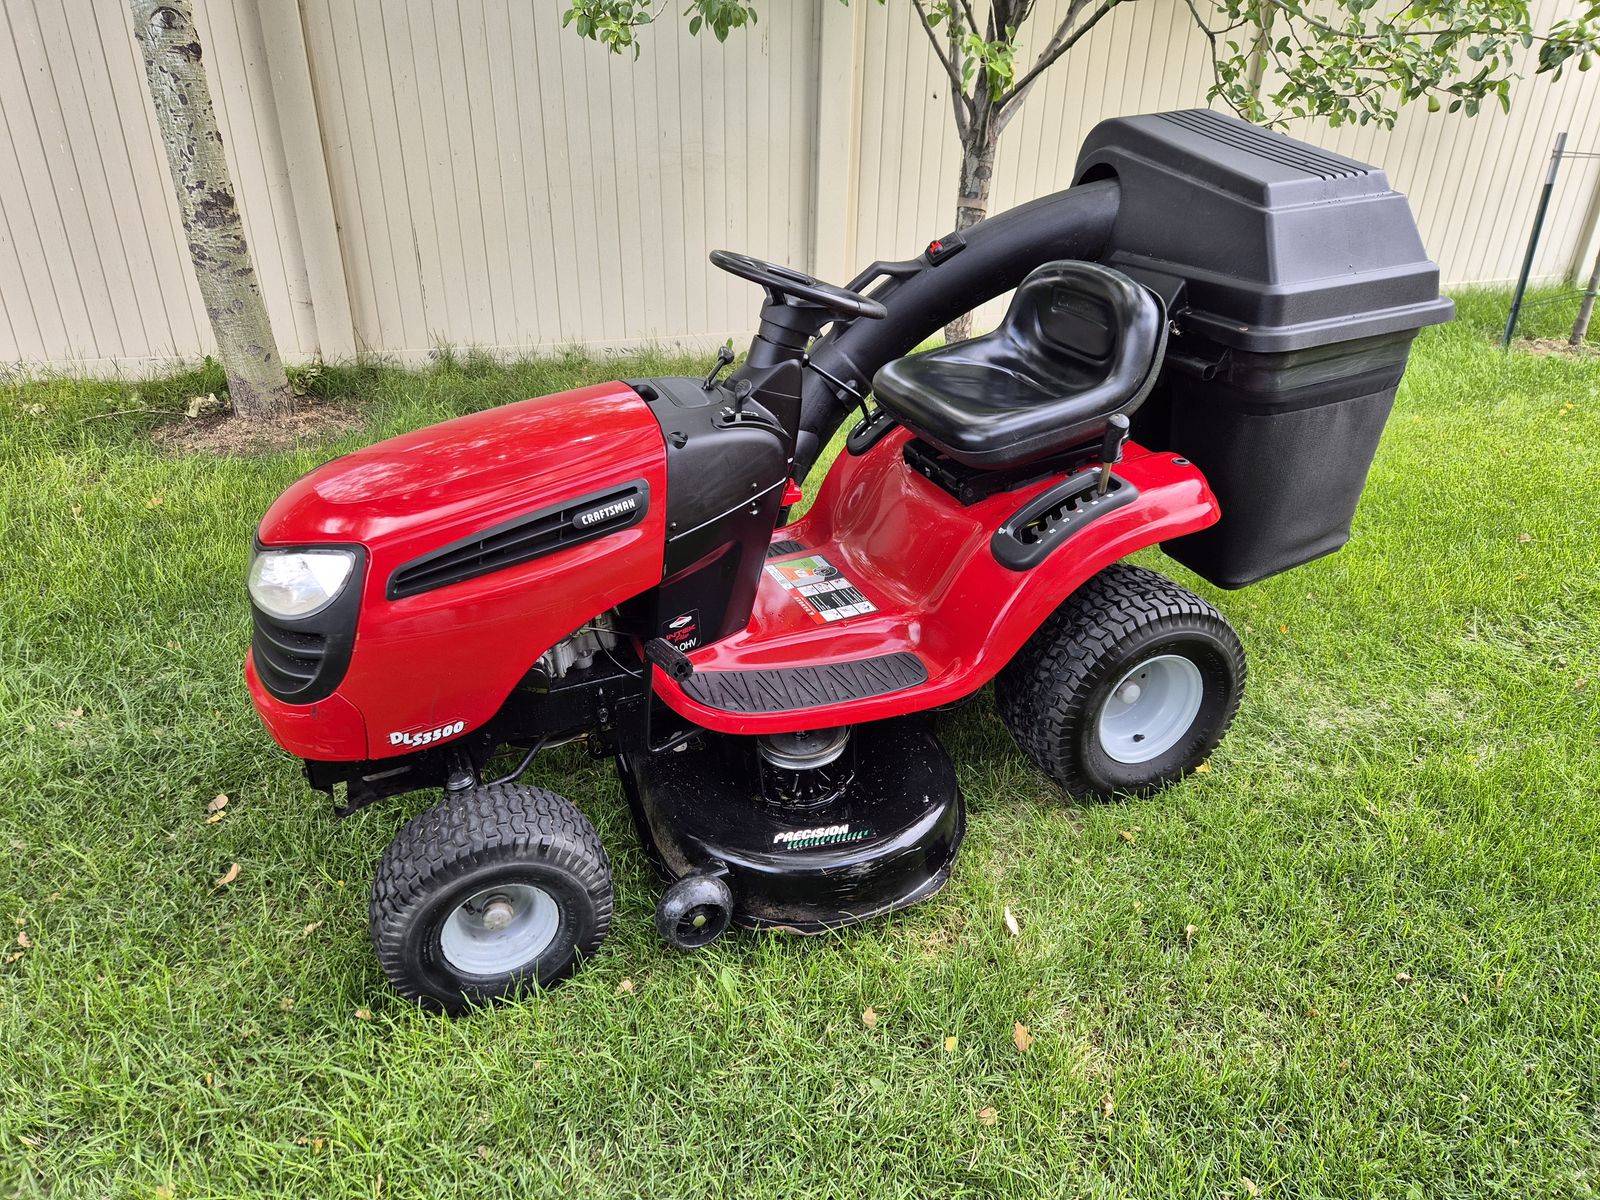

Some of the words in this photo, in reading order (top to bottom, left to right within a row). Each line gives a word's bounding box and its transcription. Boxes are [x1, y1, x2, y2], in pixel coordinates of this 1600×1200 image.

[581, 498, 636, 525] CRAFTSMAN
[680, 637, 697, 651] OHV
[773, 823, 850, 844] PRECISION
